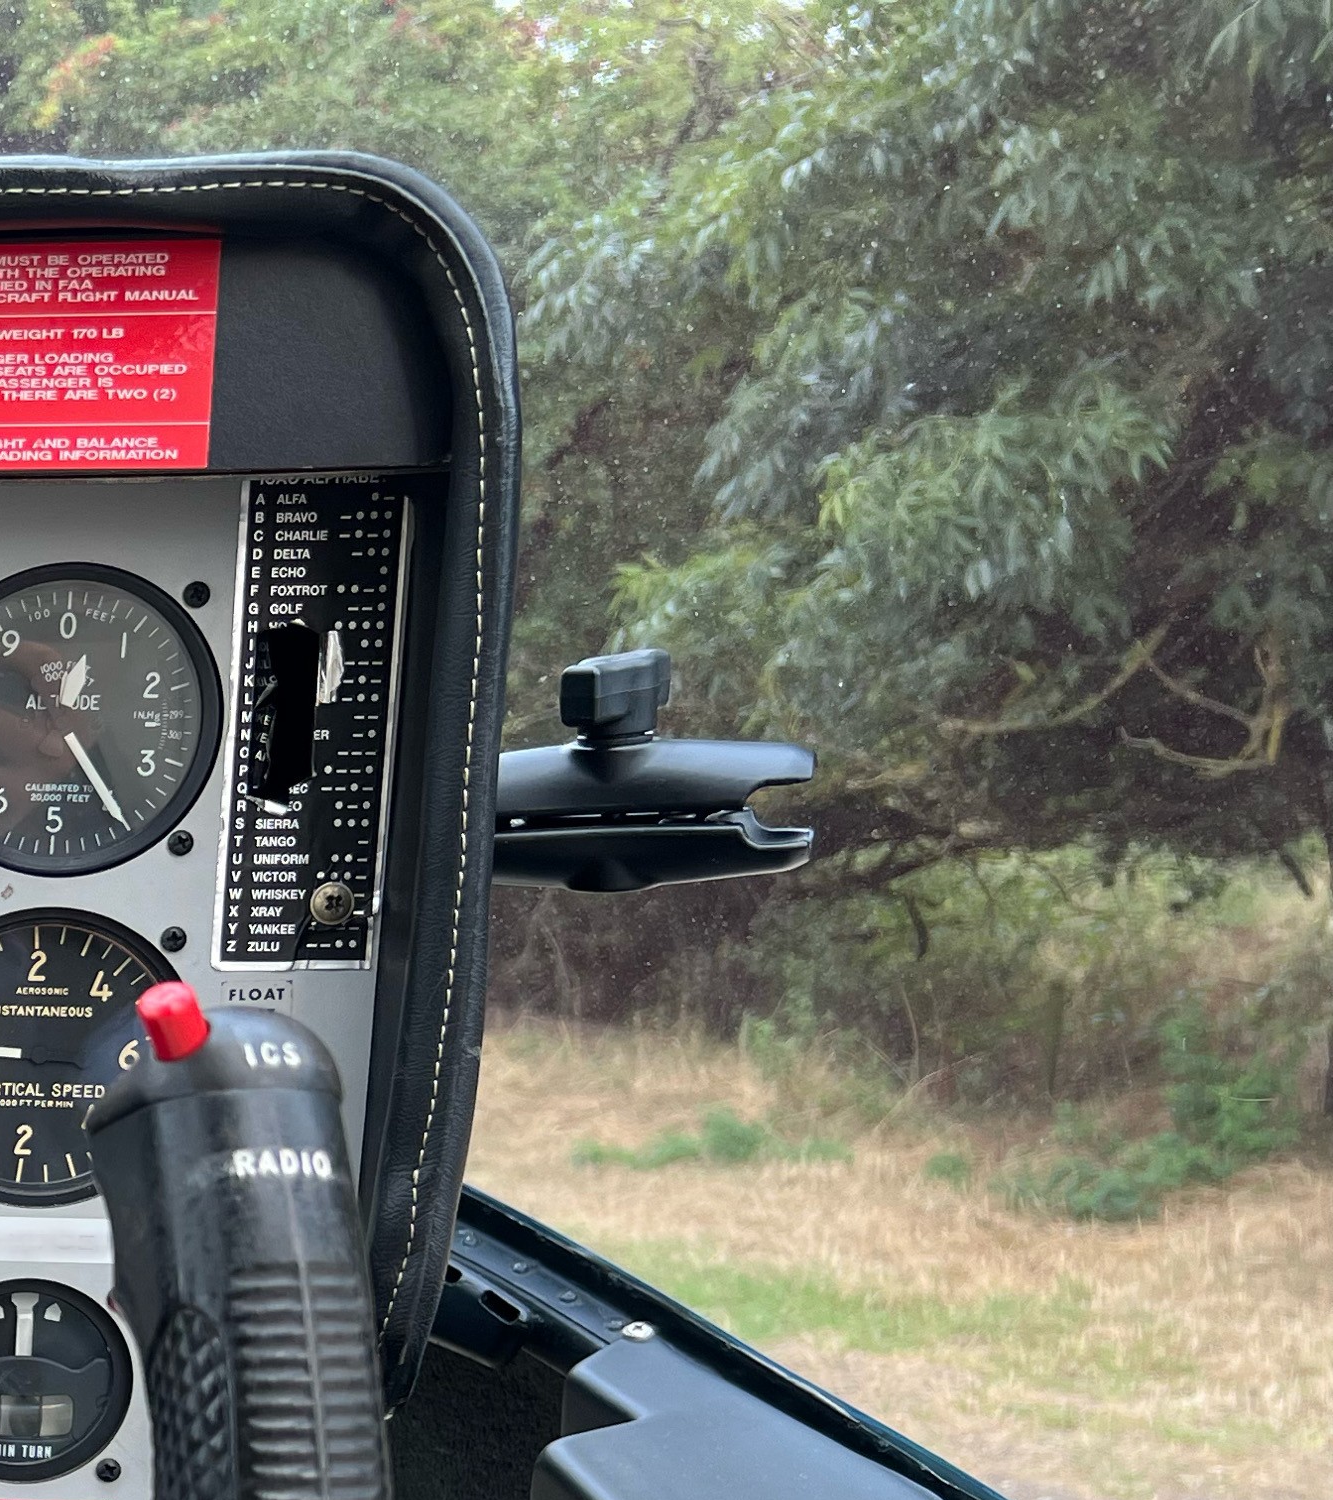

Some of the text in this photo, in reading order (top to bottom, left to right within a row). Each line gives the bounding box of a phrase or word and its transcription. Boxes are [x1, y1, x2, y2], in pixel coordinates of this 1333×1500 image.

[47, 255, 71, 266] BE
[78, 253, 168, 266] OPERATED
[26, 267, 59, 279] THE
[66, 266, 165, 278] OPERATING
[35, 280, 52, 292] IN
[57, 279, 93, 291] FAA
[57, 291, 118, 302] FLIGHT
[124, 289, 198, 302] MANUAL
[71, 328, 96, 340] 170
[101, 328, 124, 339] LB
[35, 352, 114, 364] LOADING
[53, 366, 89, 376] ARE
[94, 364, 188, 376] OCCUPIED
[98, 377, 114, 388] IS
[1, 390, 58, 402] THERE
[64, 390, 100, 400] ARE
[106, 388, 148, 400] TWO
[152, 388, 178, 402] (2)
[33, 438, 70, 450] AND
[76, 437, 158, 450] BALANCE
[60, 449, 178, 461] INFORMATION
[276, 512, 318, 523] BRAVO
[276, 530, 328, 541] CHARLIE
[274, 548, 310, 560] DELTA
[272, 567, 306, 578] ECHO
[270, 585, 328, 596] FOXTROT
[270, 604, 303, 615] GOLF
[251, 888, 306, 900] WHISKEY
[228, 988, 285, 1001] FLOAT
[243, 1041, 301, 1068] ICS
[51, 1084, 106, 1100] SPEED
[231, 1148, 332, 1179] RADIO
